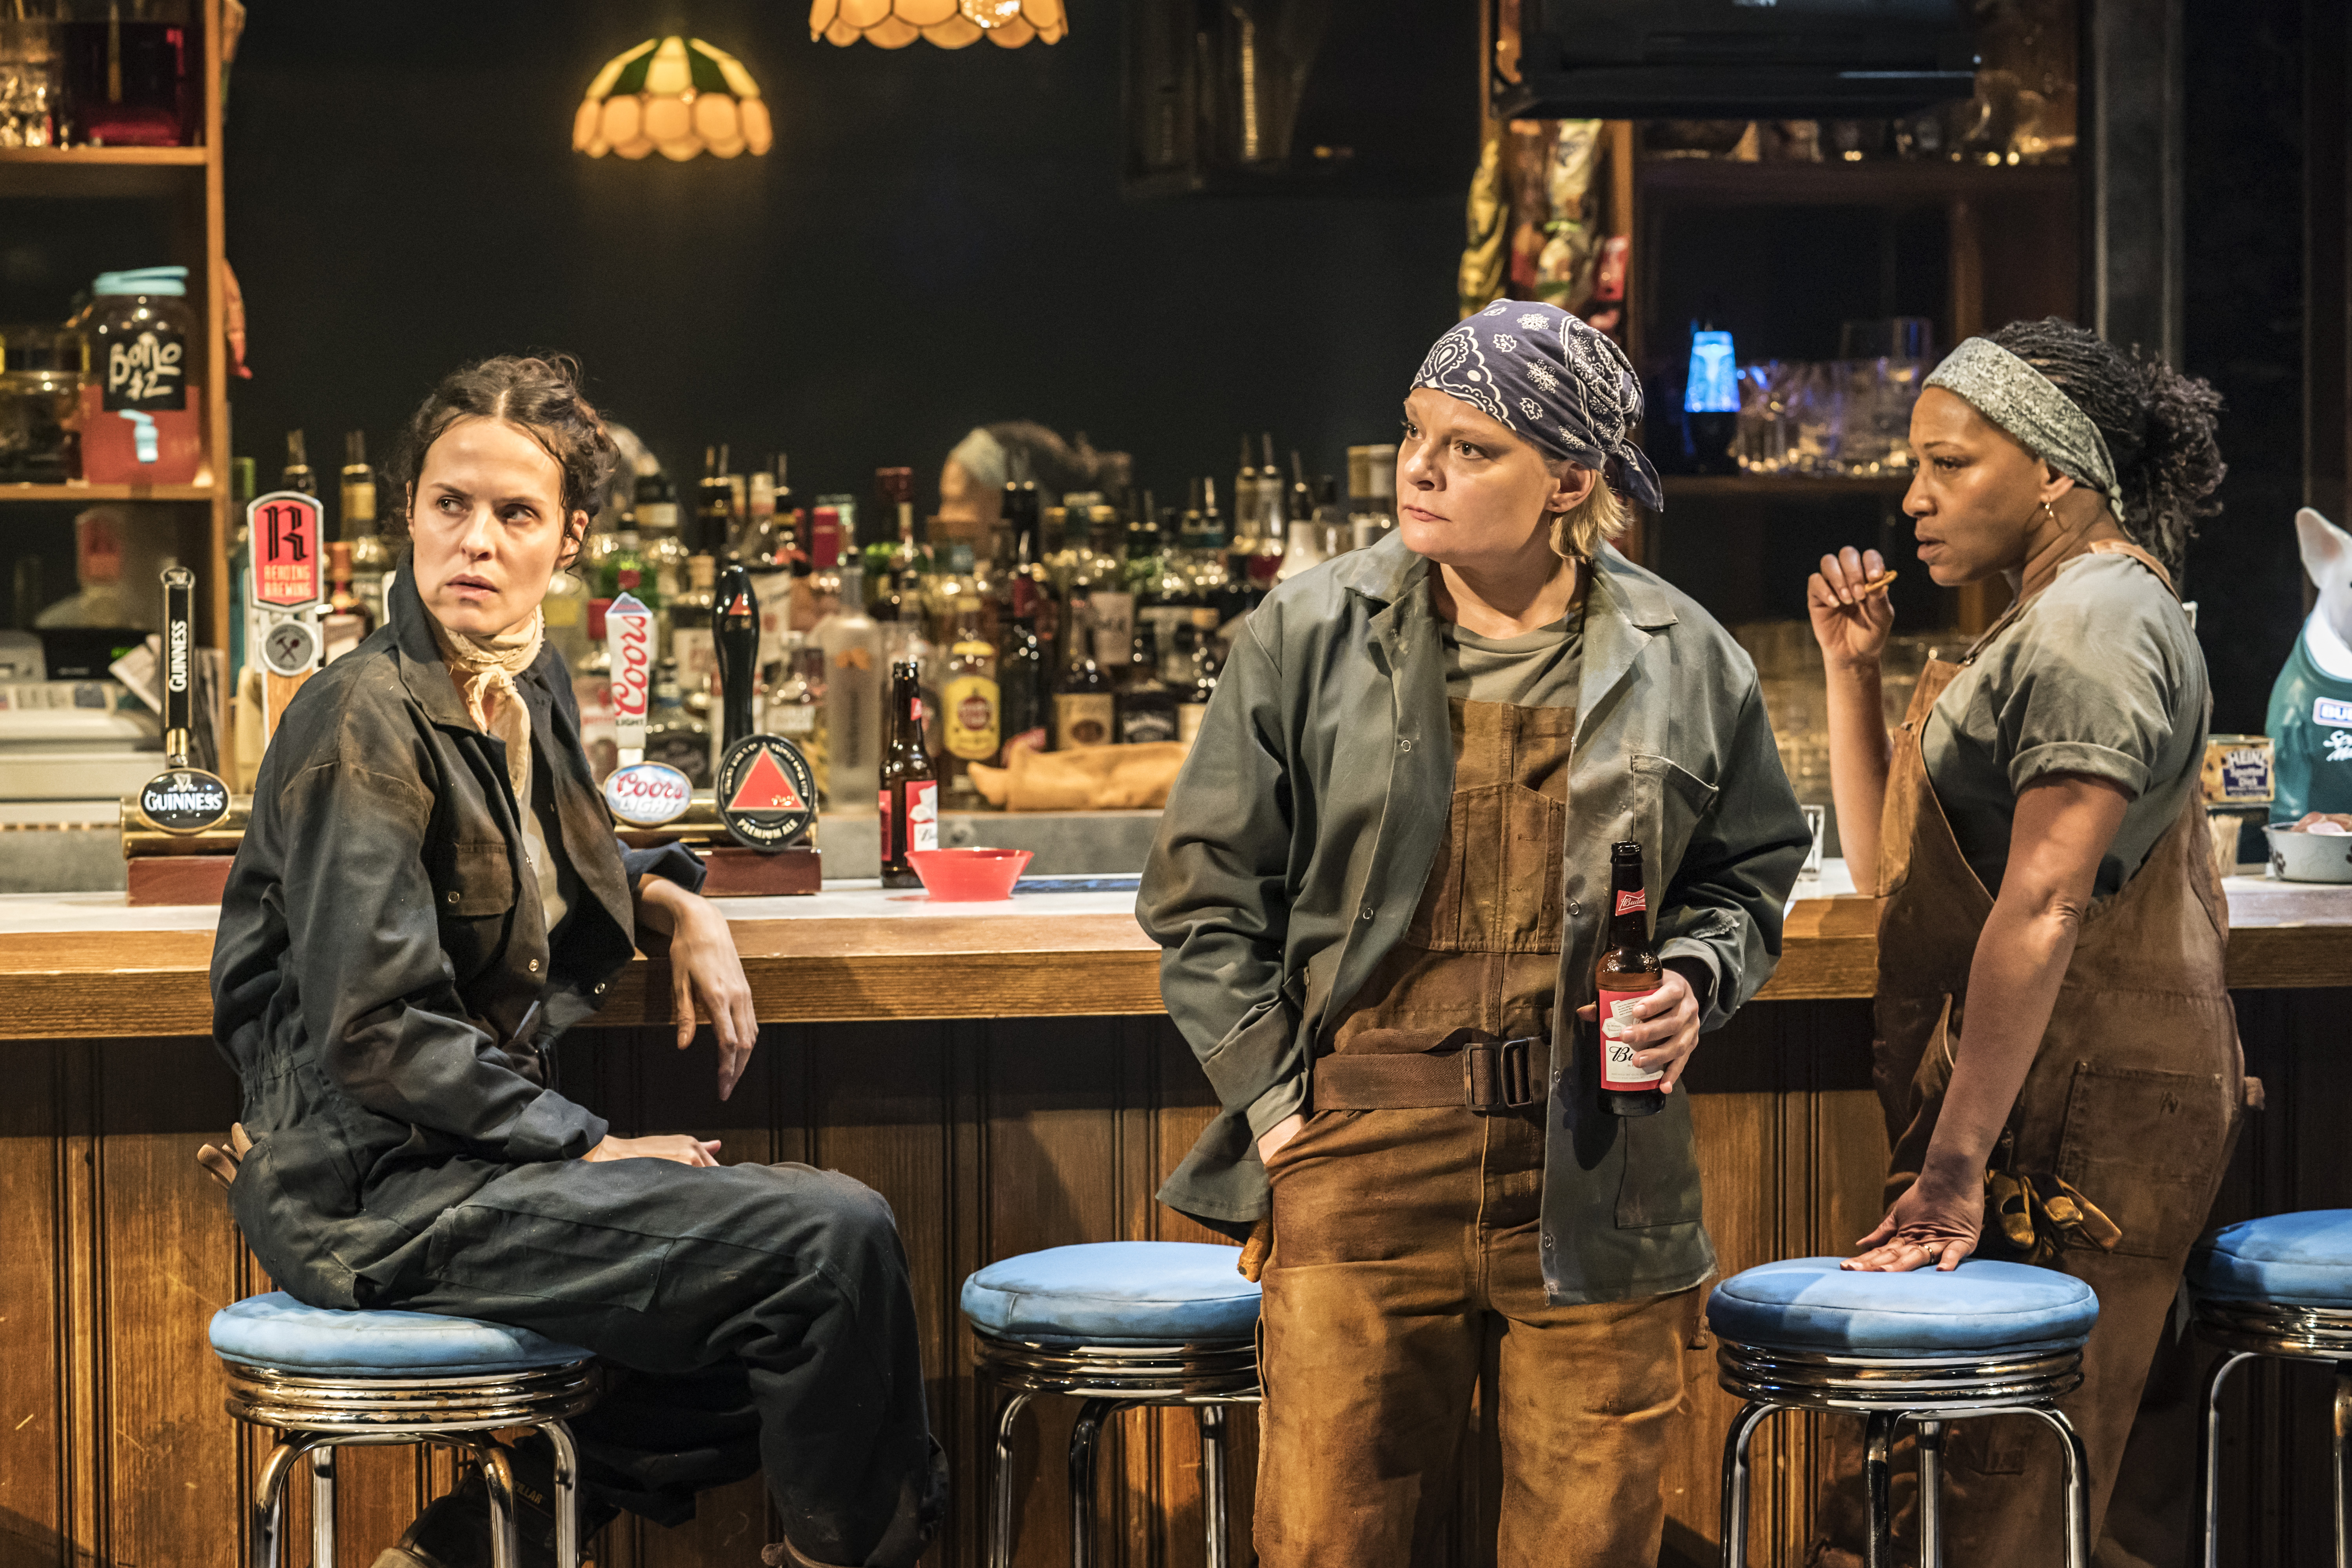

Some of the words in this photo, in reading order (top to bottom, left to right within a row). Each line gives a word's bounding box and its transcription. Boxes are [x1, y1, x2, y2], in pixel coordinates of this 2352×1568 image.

[263, 506, 308, 561] R
[264, 581, 311, 597] BREWING
[169, 619, 187, 692] GUINNESS
[612, 616, 647, 716] Coors
[616, 771, 684, 799] Coors
[144, 791, 223, 811] GUINNESS
[619, 798, 679, 814] LIGHT
[737, 818, 782, 839] PREMIUM
[782, 818, 798, 835] ALE
